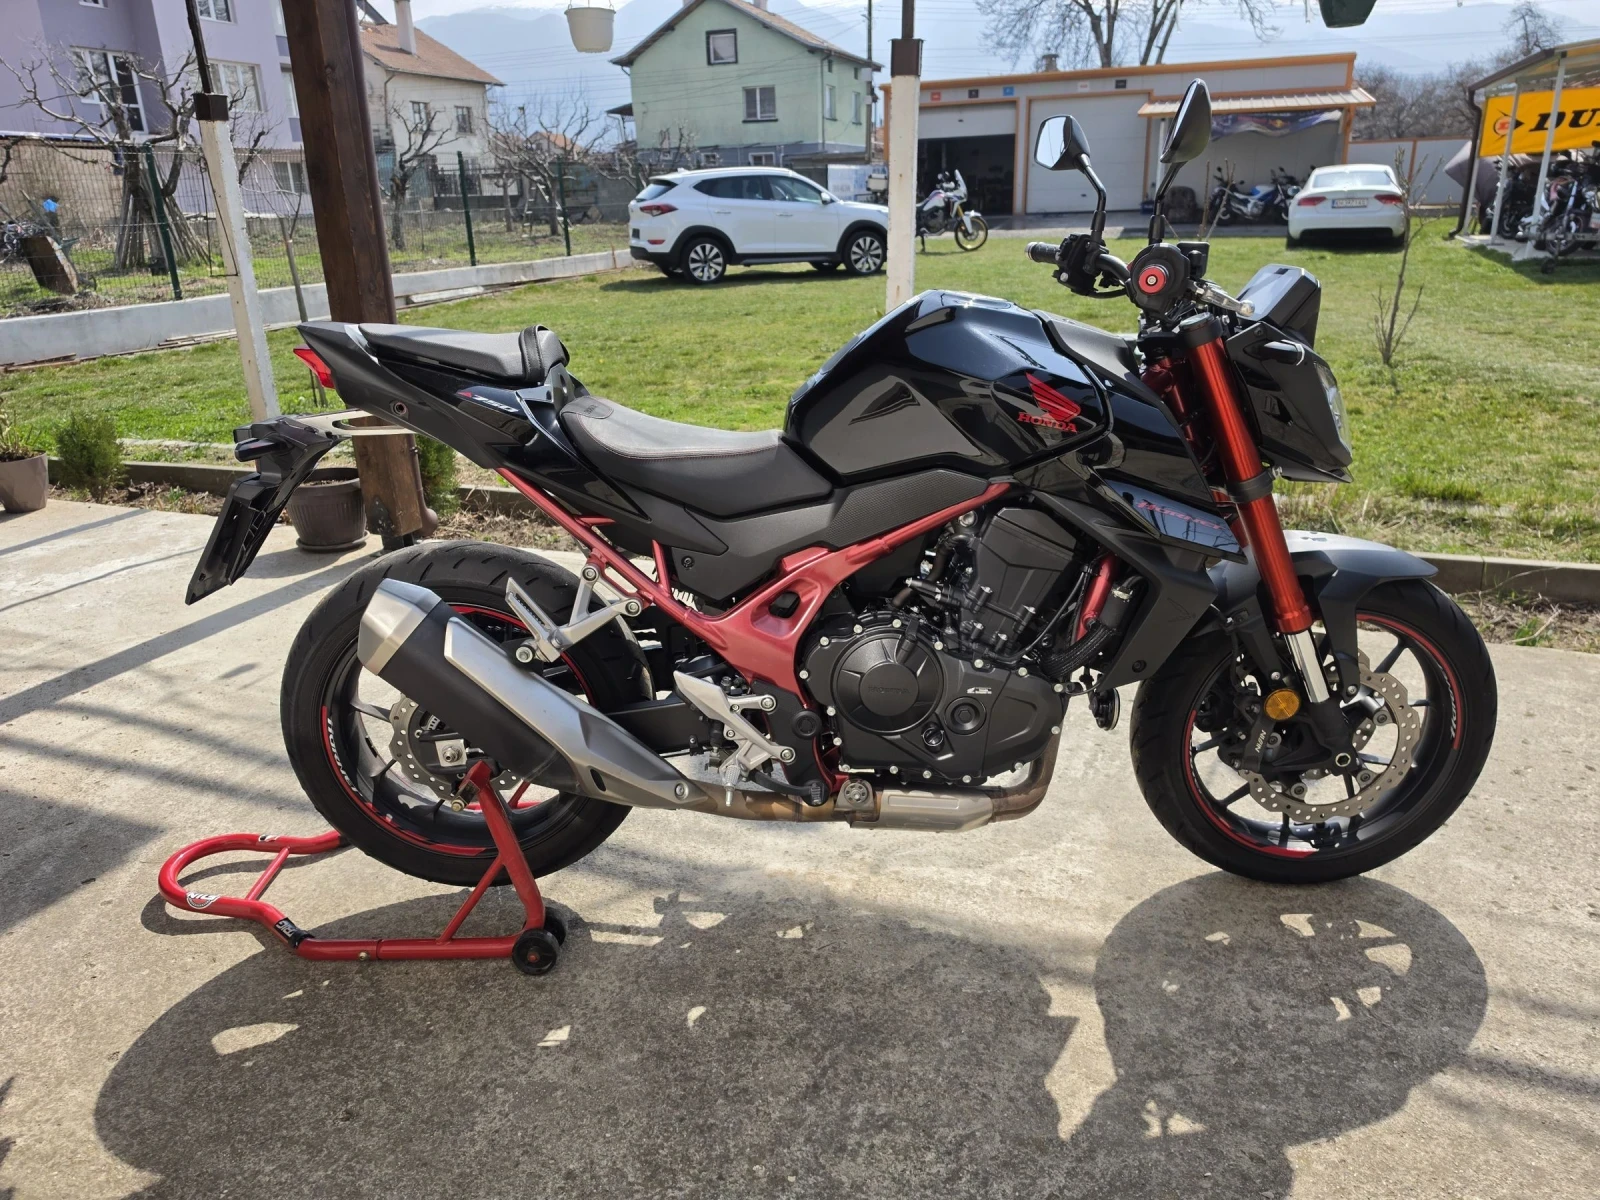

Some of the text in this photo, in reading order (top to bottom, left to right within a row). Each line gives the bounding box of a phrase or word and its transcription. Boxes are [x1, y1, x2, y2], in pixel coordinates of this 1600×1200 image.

[1528, 107, 1600, 132] DU
[472, 394, 519, 412] 750
[1017, 412, 1077, 433] HONDA
